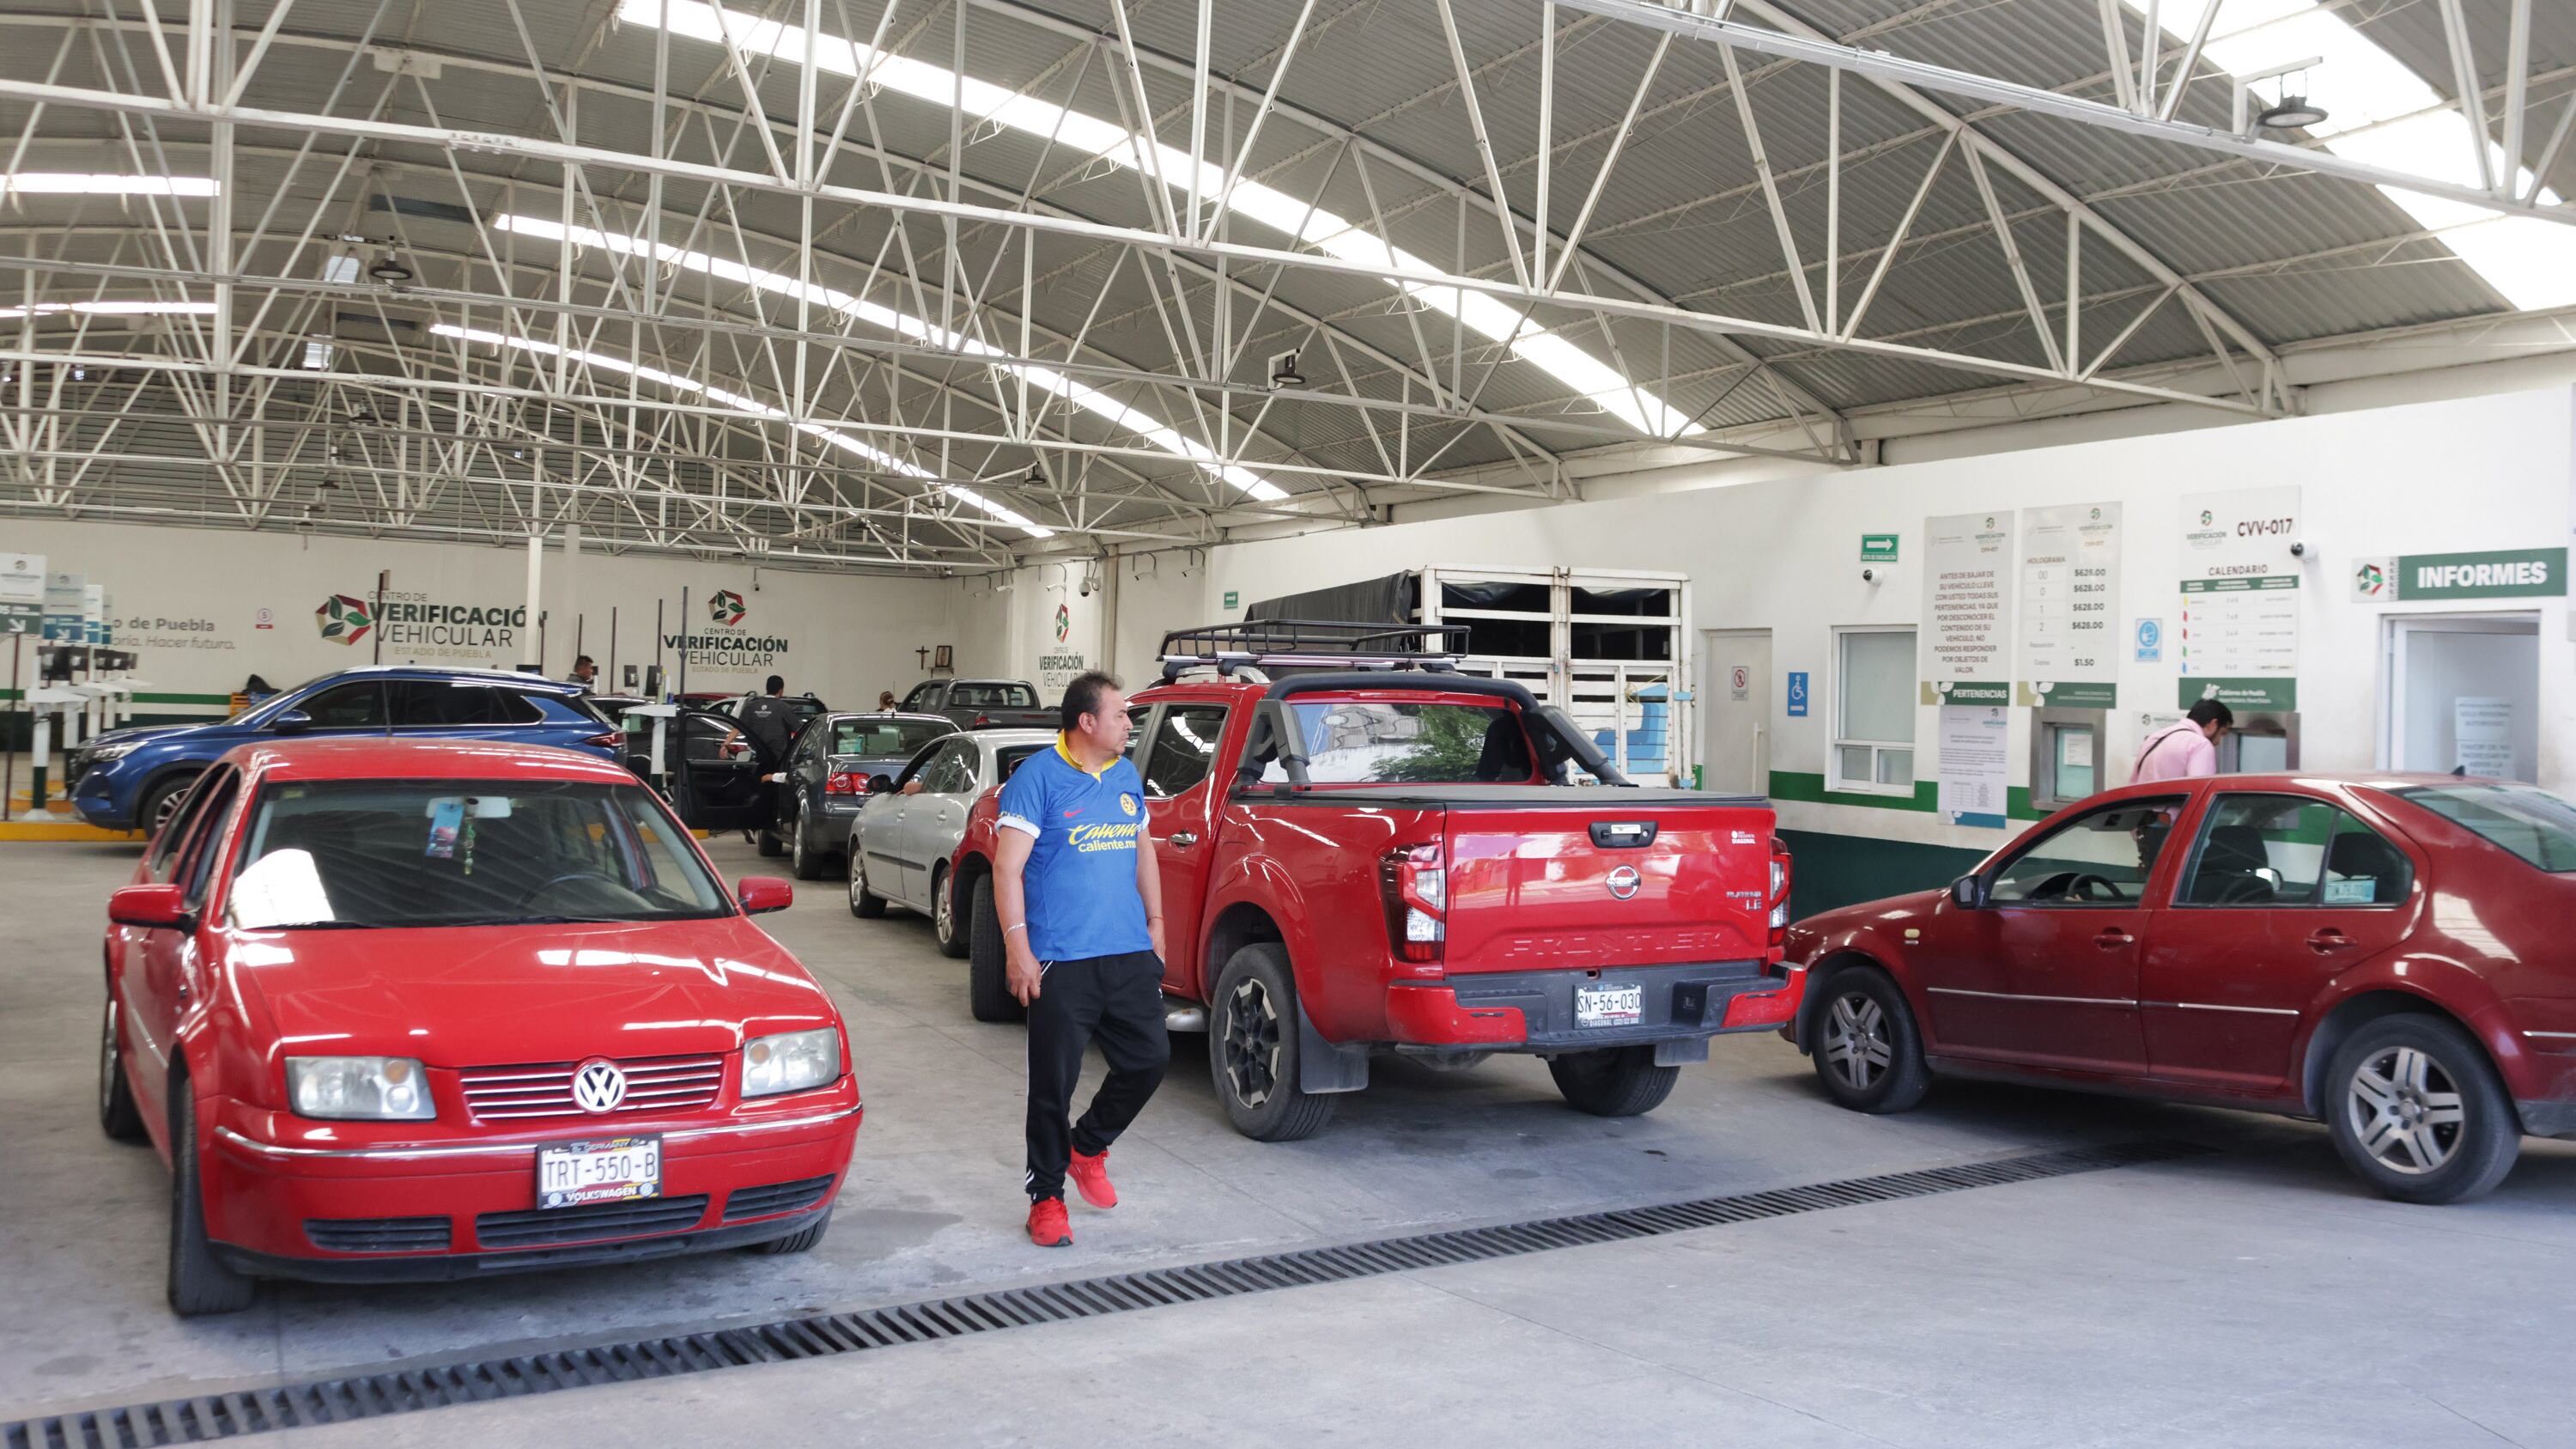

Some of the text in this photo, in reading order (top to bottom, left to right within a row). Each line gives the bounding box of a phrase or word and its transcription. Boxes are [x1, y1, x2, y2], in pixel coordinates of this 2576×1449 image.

[2238, 519, 2293, 537] CVV-017
[2208, 564, 2268, 576] CALENDARIO
[2417, 561, 2548, 588] INFORMES
[413, 593, 427, 602] DE
[129, 617, 150, 630] de
[155, 618, 215, 631] Puebla
[704, 627, 736, 636] CENTRO
[148, 636, 188, 648] Hacer
[375, 624, 513, 648] VEHICULAR
[663, 634, 788, 653] VERIFICACIÓN
[394, 646, 491, 659] ESTADO DE PUEBLA
[678, 650, 773, 667] VEHICULAR
[1039, 651, 1084, 671] VERIFICACIÓN
[2075, 658, 2095, 667] $1.50
[1953, 688, 2008, 699] PERTENENCIAS
[1067, 824, 1140, 846] Caliente
[1078, 839, 1136, 853] caliente.m
[1746, 899, 1762, 910] LE
[1577, 993, 1642, 1014] SN-56-030
[545, 1152, 656, 1188] TRT-550-B
[566, 1186, 637, 1202] VOLKSWAGEN
